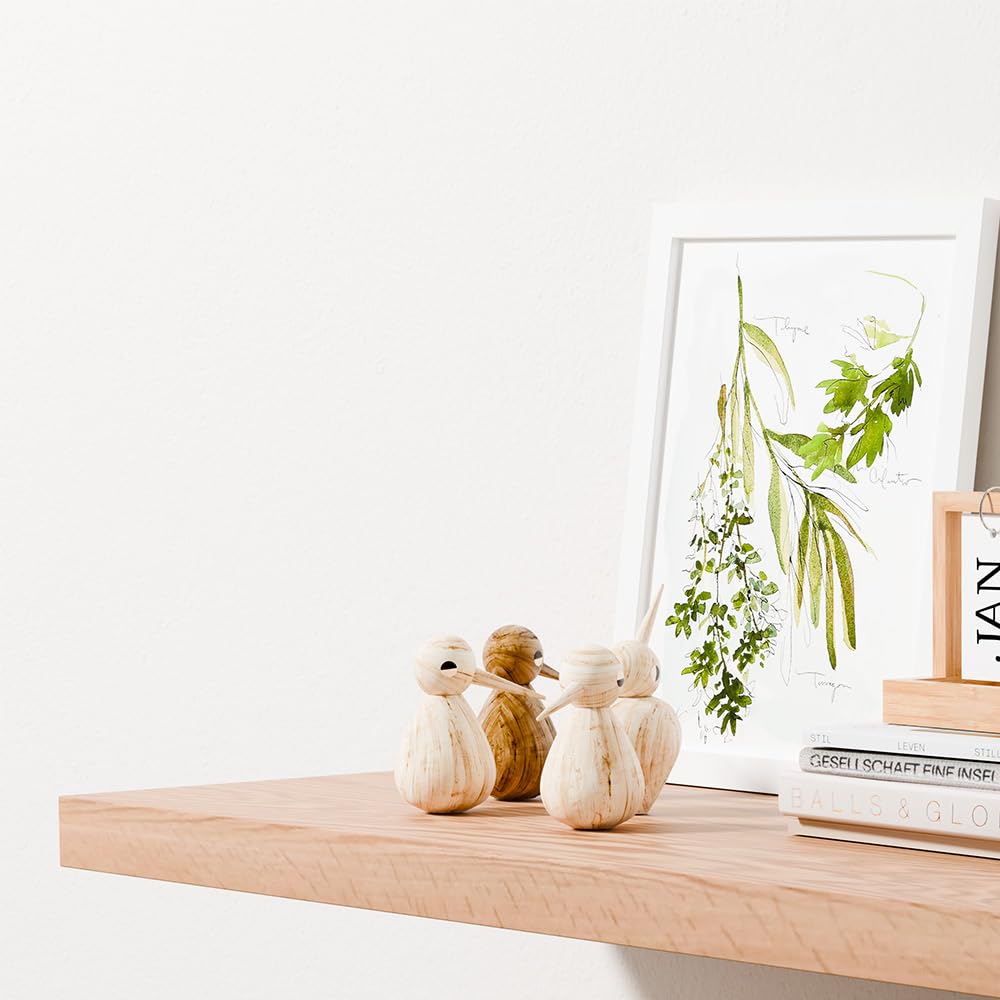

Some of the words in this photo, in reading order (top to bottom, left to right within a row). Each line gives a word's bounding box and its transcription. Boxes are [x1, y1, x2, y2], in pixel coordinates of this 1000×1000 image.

[810, 734, 832, 745] STIL
[897, 741, 926, 752] LEVEN
[791, 786, 882, 817] BALLS
[898, 797, 910, 820] &
